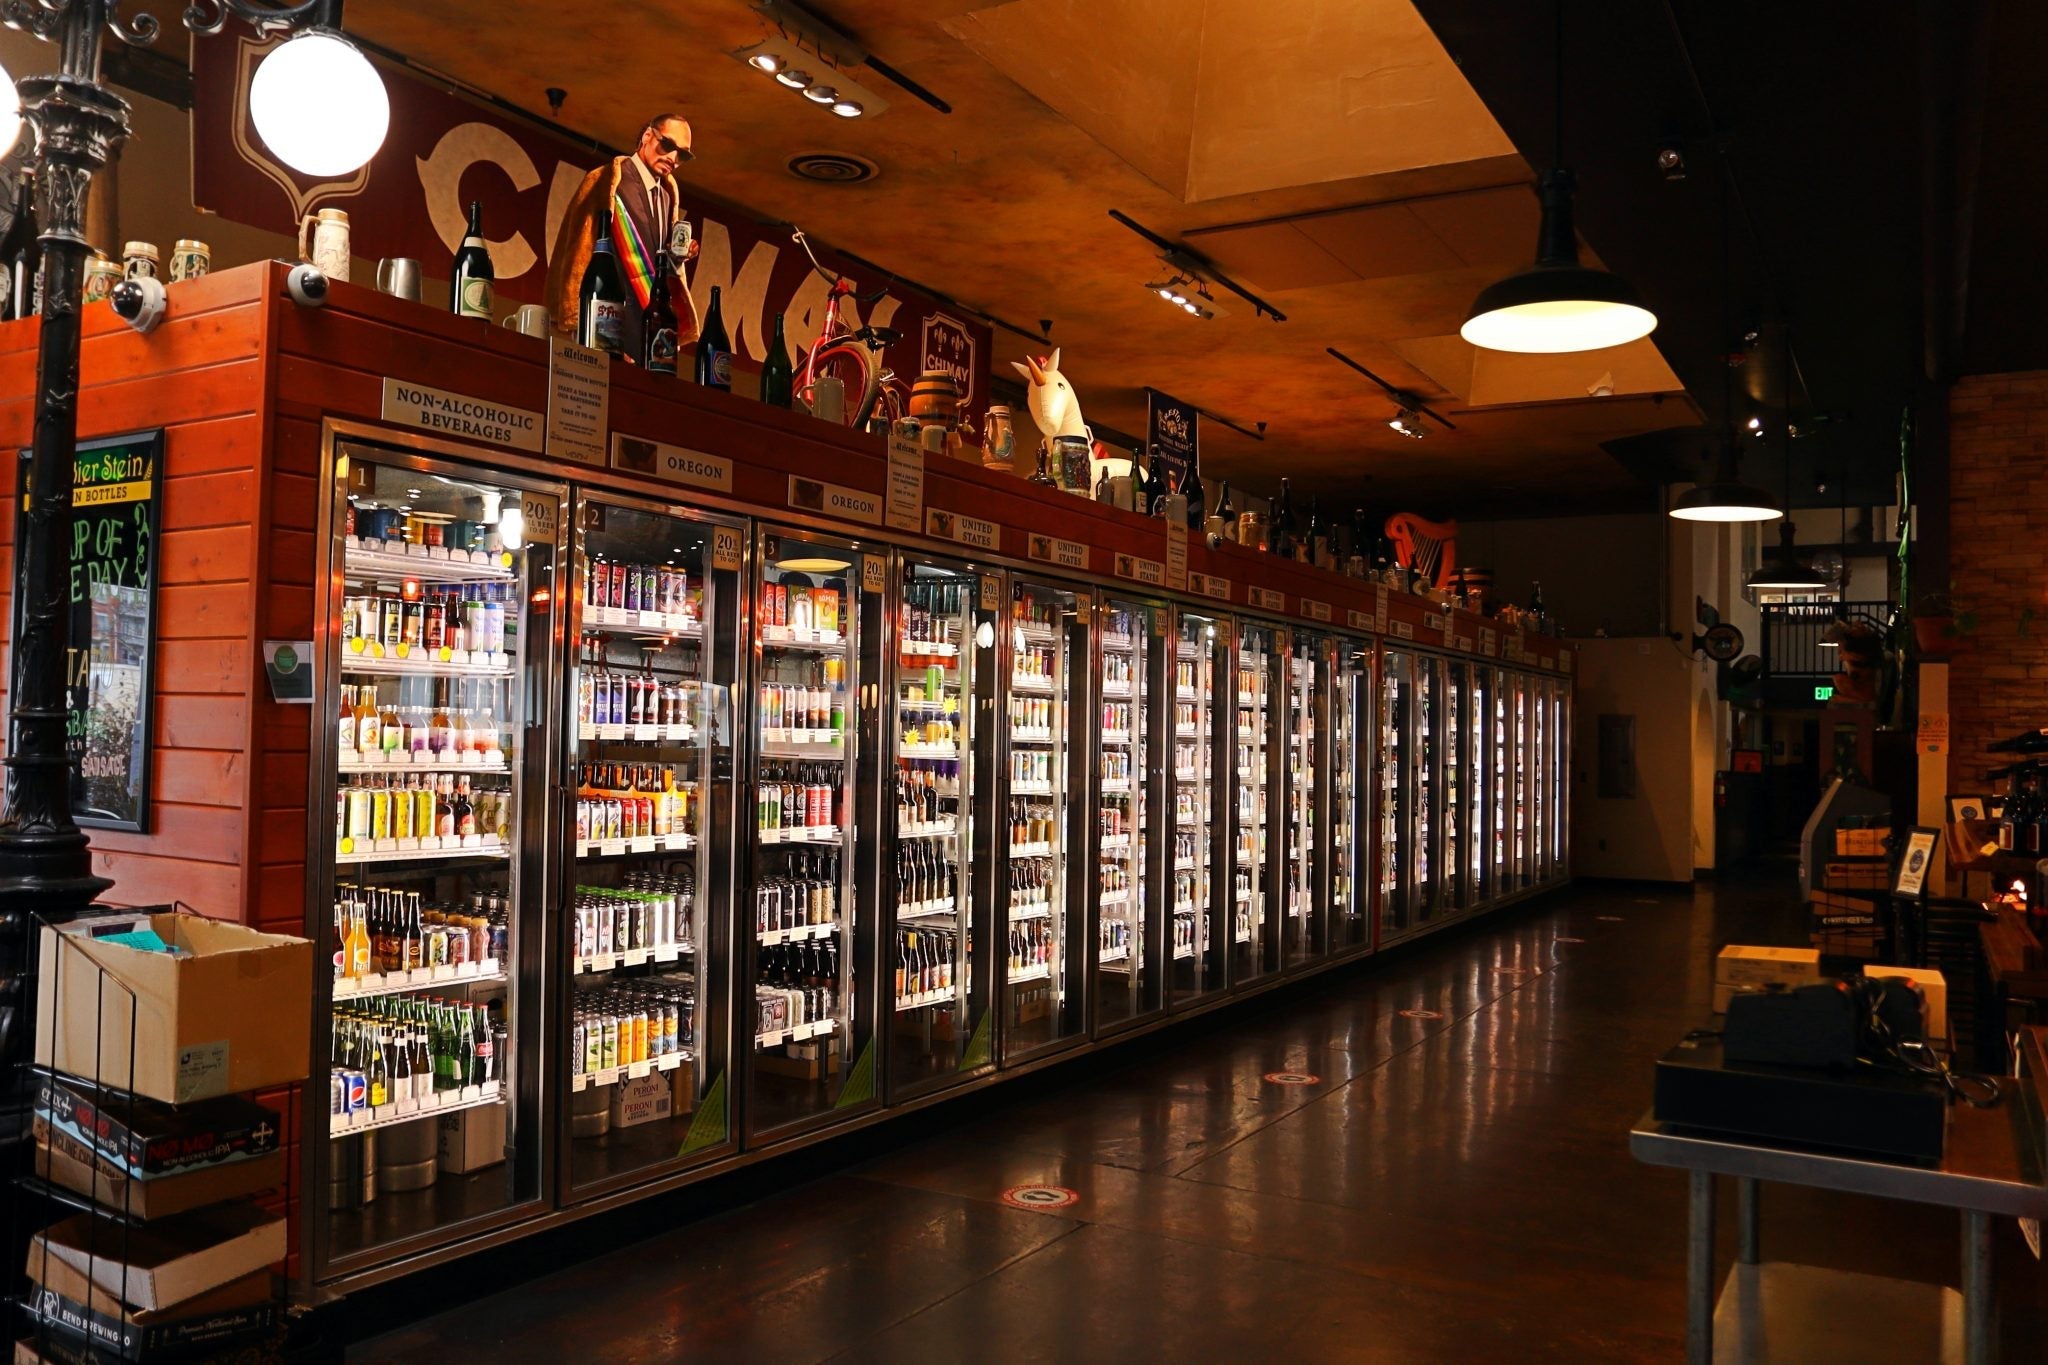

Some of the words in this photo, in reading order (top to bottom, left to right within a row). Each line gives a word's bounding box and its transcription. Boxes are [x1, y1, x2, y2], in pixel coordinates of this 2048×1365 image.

[415, 121, 903, 374] CMAY
[563, 346, 598, 365] Welcome
[927, 353, 969, 382] CHIMAY
[396, 387, 534, 430] NON-ALCOHOLIC
[420, 411, 512, 442] BEVERAGES
[73, 457, 100, 486] ier
[101, 452, 143, 481] Stein
[667, 456, 723, 480] OREGON
[358, 467, 366, 487] 1
[86, 486, 128, 502] BOTTLES
[831, 494, 874, 514] OREGON
[590, 509, 600, 526] 2
[962, 518, 993, 534] UNITED
[95, 518, 124, 559] OF
[962, 531, 991, 546] STATES
[769, 540, 775, 555] 3
[1057, 541, 1083, 555] UNITED
[1058, 553, 1082, 566] STATES
[1138, 560, 1160, 573] UNITED
[88, 556, 128, 600] DAY
[905, 566, 911, 578] 4
[1139, 570, 1159, 583] STATES
[1015, 585, 1020, 595] 5
[1815, 687, 1833, 700] EXIT
[633, 1084, 659, 1096] PERONI
[624, 1101, 652, 1114] PERONI
[215, 1143, 231, 1157] IPA
[62, 1309, 81, 1328] BEND
[82, 1314, 118, 1341] BREWING
